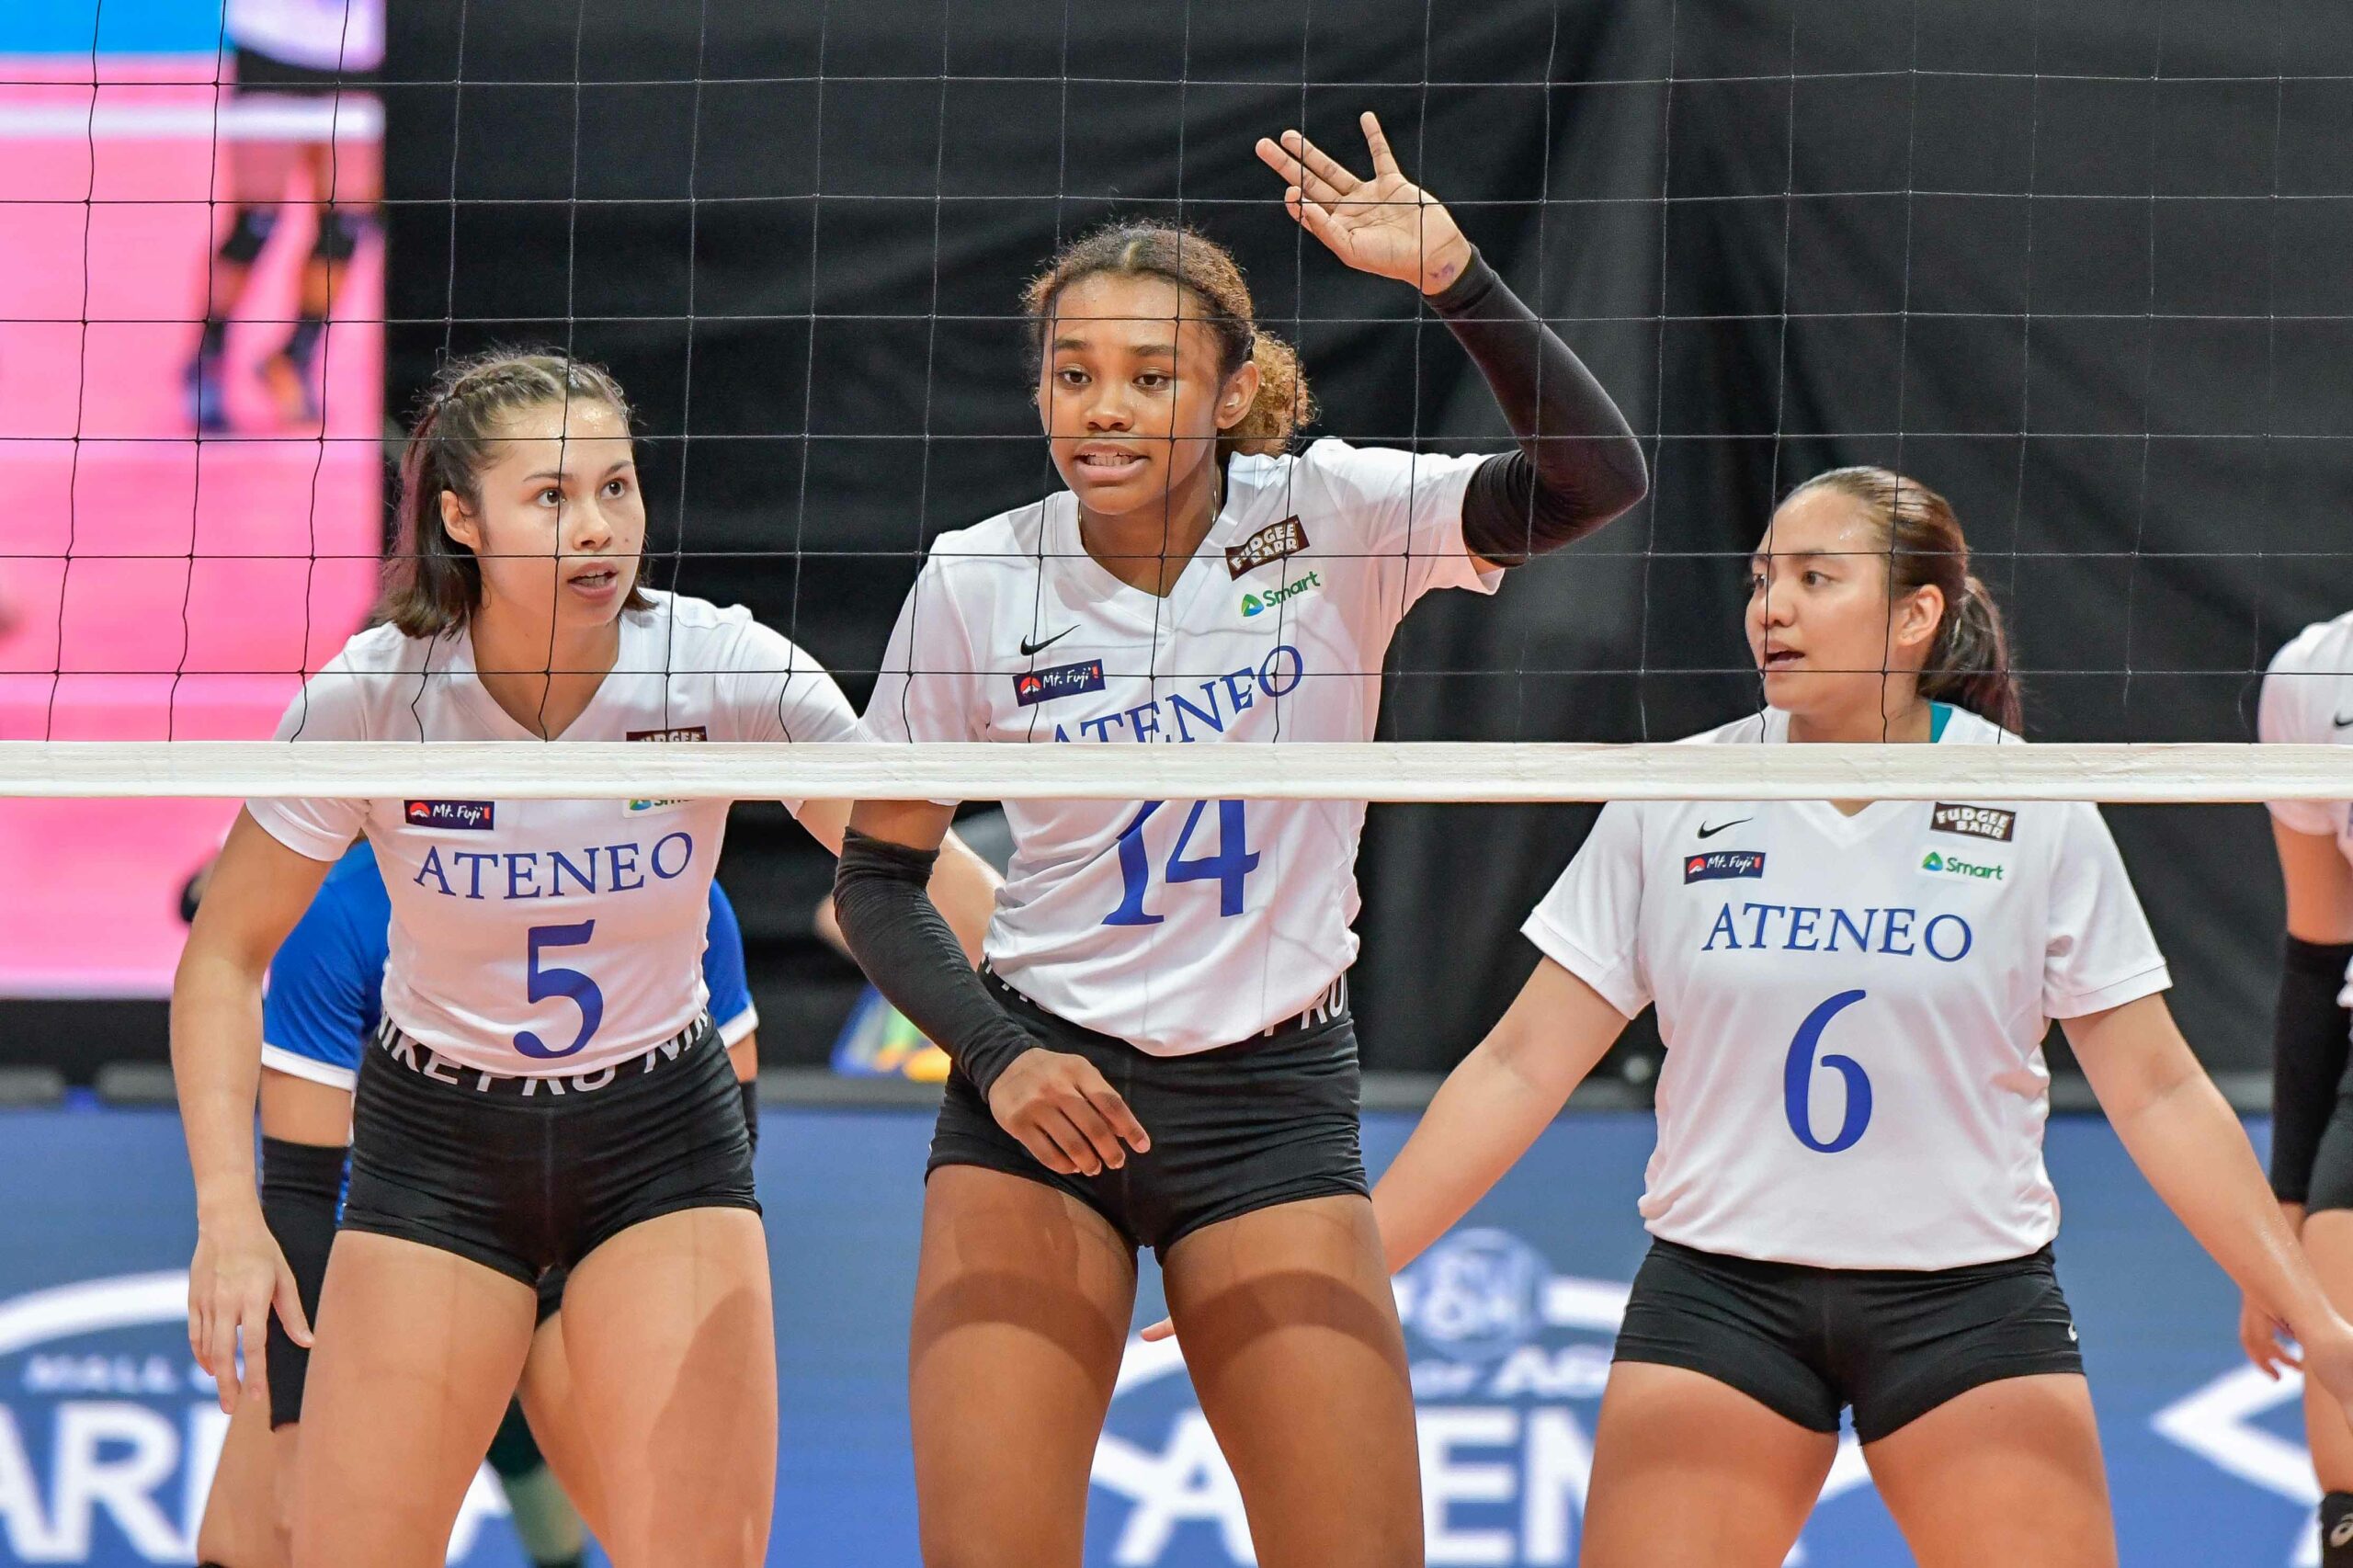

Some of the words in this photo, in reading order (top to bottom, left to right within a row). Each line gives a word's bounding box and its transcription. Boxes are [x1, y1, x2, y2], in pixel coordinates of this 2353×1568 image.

[1263, 571, 1321, 607] Smart
[1042, 672, 1063, 688] Mt.
[1054, 645, 1303, 744] TENEO
[432, 803, 454, 817] Mt.
[457, 805, 483, 826] Fuji
[1936, 808, 2010, 828] FUDGEE
[413, 832, 693, 900] ATENEO
[1100, 800, 1261, 926] 14
[1706, 855, 1727, 869] Mt.
[1729, 855, 1755, 874] Fuji
[1946, 857, 2004, 881] Smart
[1701, 903, 1972, 962] ATENEO
[513, 919, 603, 1059] 5
[1784, 989, 1872, 1153] 6
